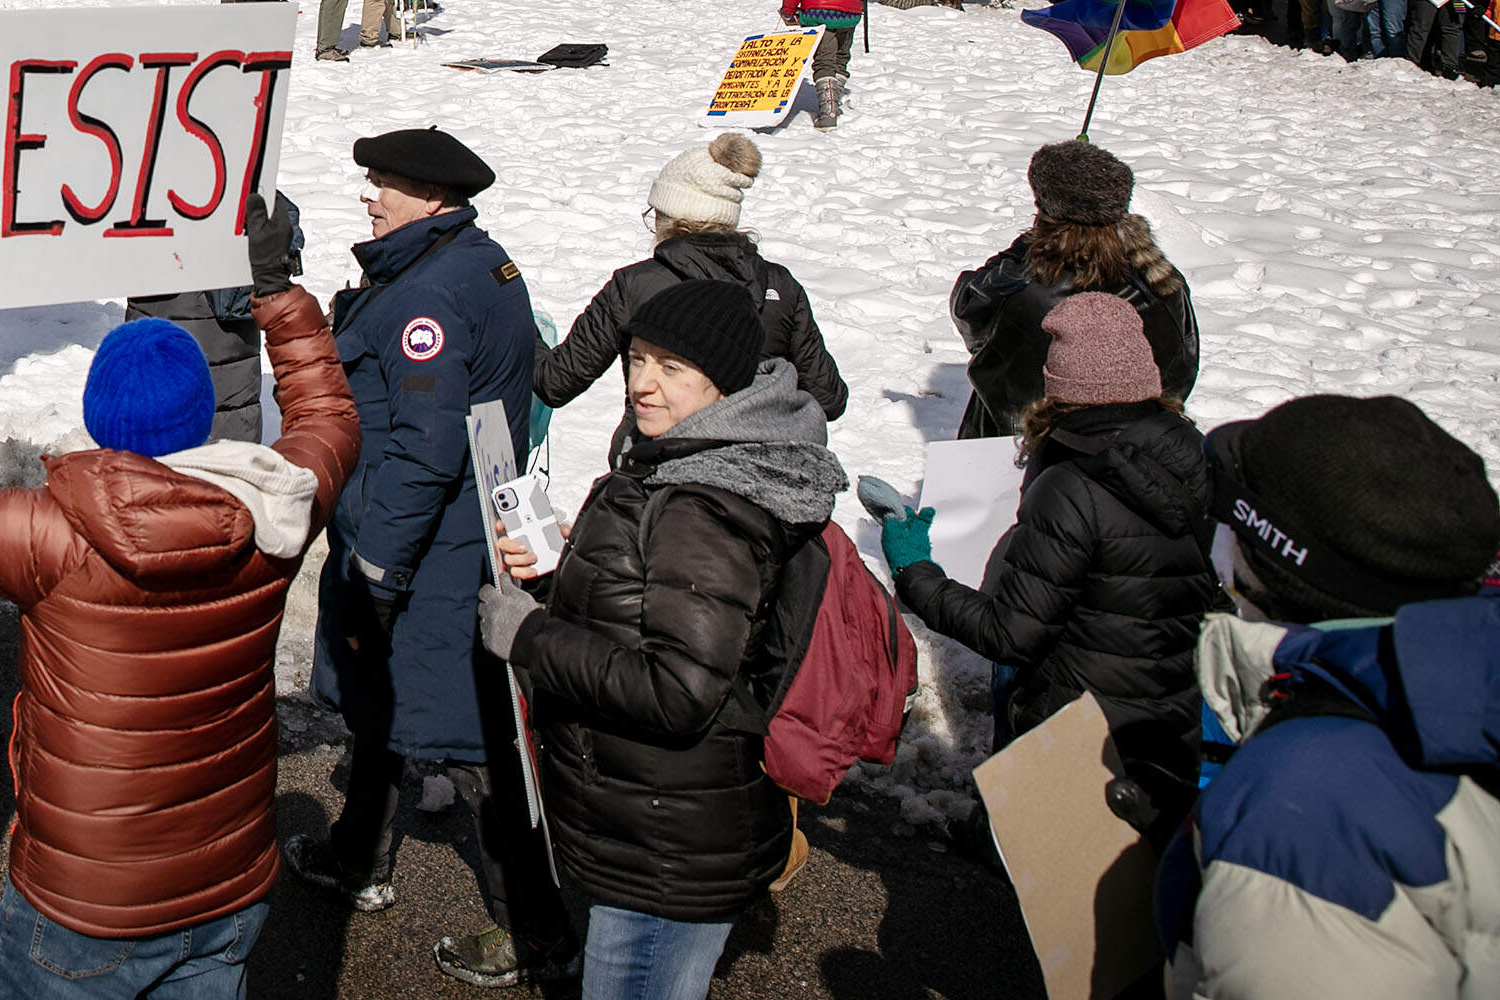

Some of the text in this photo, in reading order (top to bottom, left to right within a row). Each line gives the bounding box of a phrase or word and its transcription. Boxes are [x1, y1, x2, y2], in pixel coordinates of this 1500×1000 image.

[776, 38, 786, 47] A
[790, 37, 803, 46] LA
[791, 57, 801, 66] Y
[770, 69, 781, 78] DE
[772, 80, 780, 88] A
[785, 79, 796, 88] LA
[768, 90, 778, 98] DE
[781, 89, 790, 98] LA
[1233, 499, 1308, 566] SMITH
